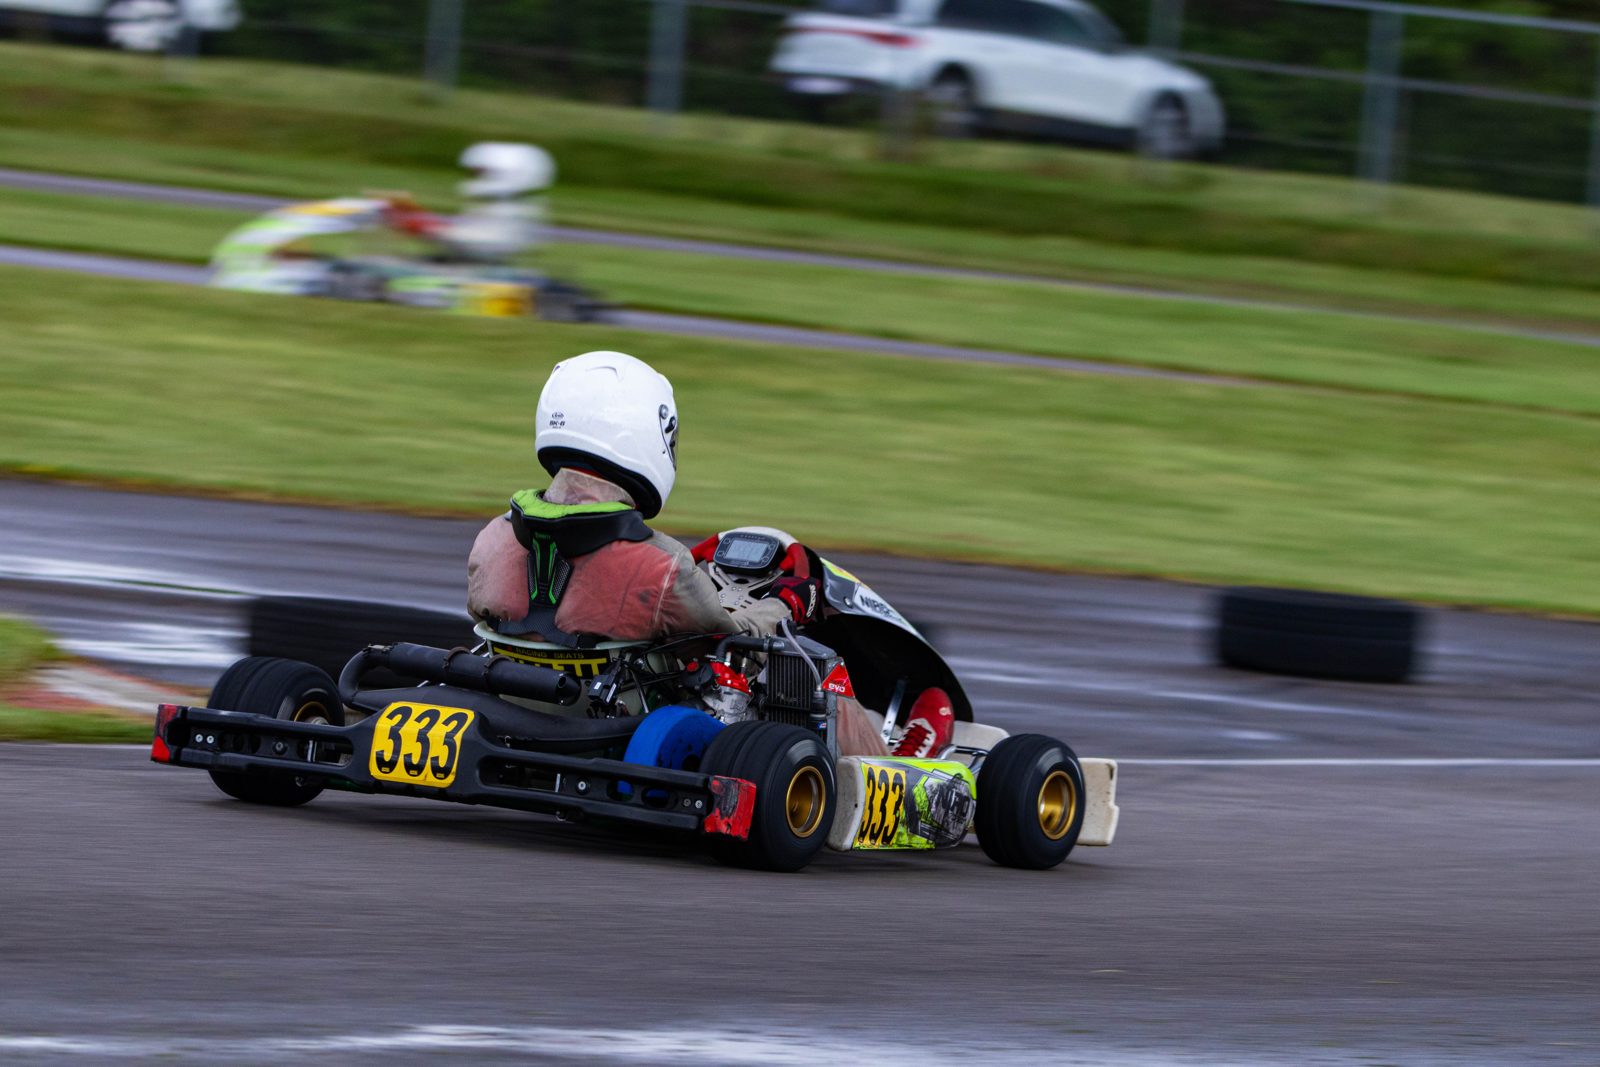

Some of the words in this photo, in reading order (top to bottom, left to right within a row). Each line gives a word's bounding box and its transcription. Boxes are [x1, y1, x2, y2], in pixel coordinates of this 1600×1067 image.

[516, 647, 547, 658] RACING
[553, 651, 585, 659] SEATS
[375, 705, 469, 780] 333
[858, 766, 904, 846] 333
